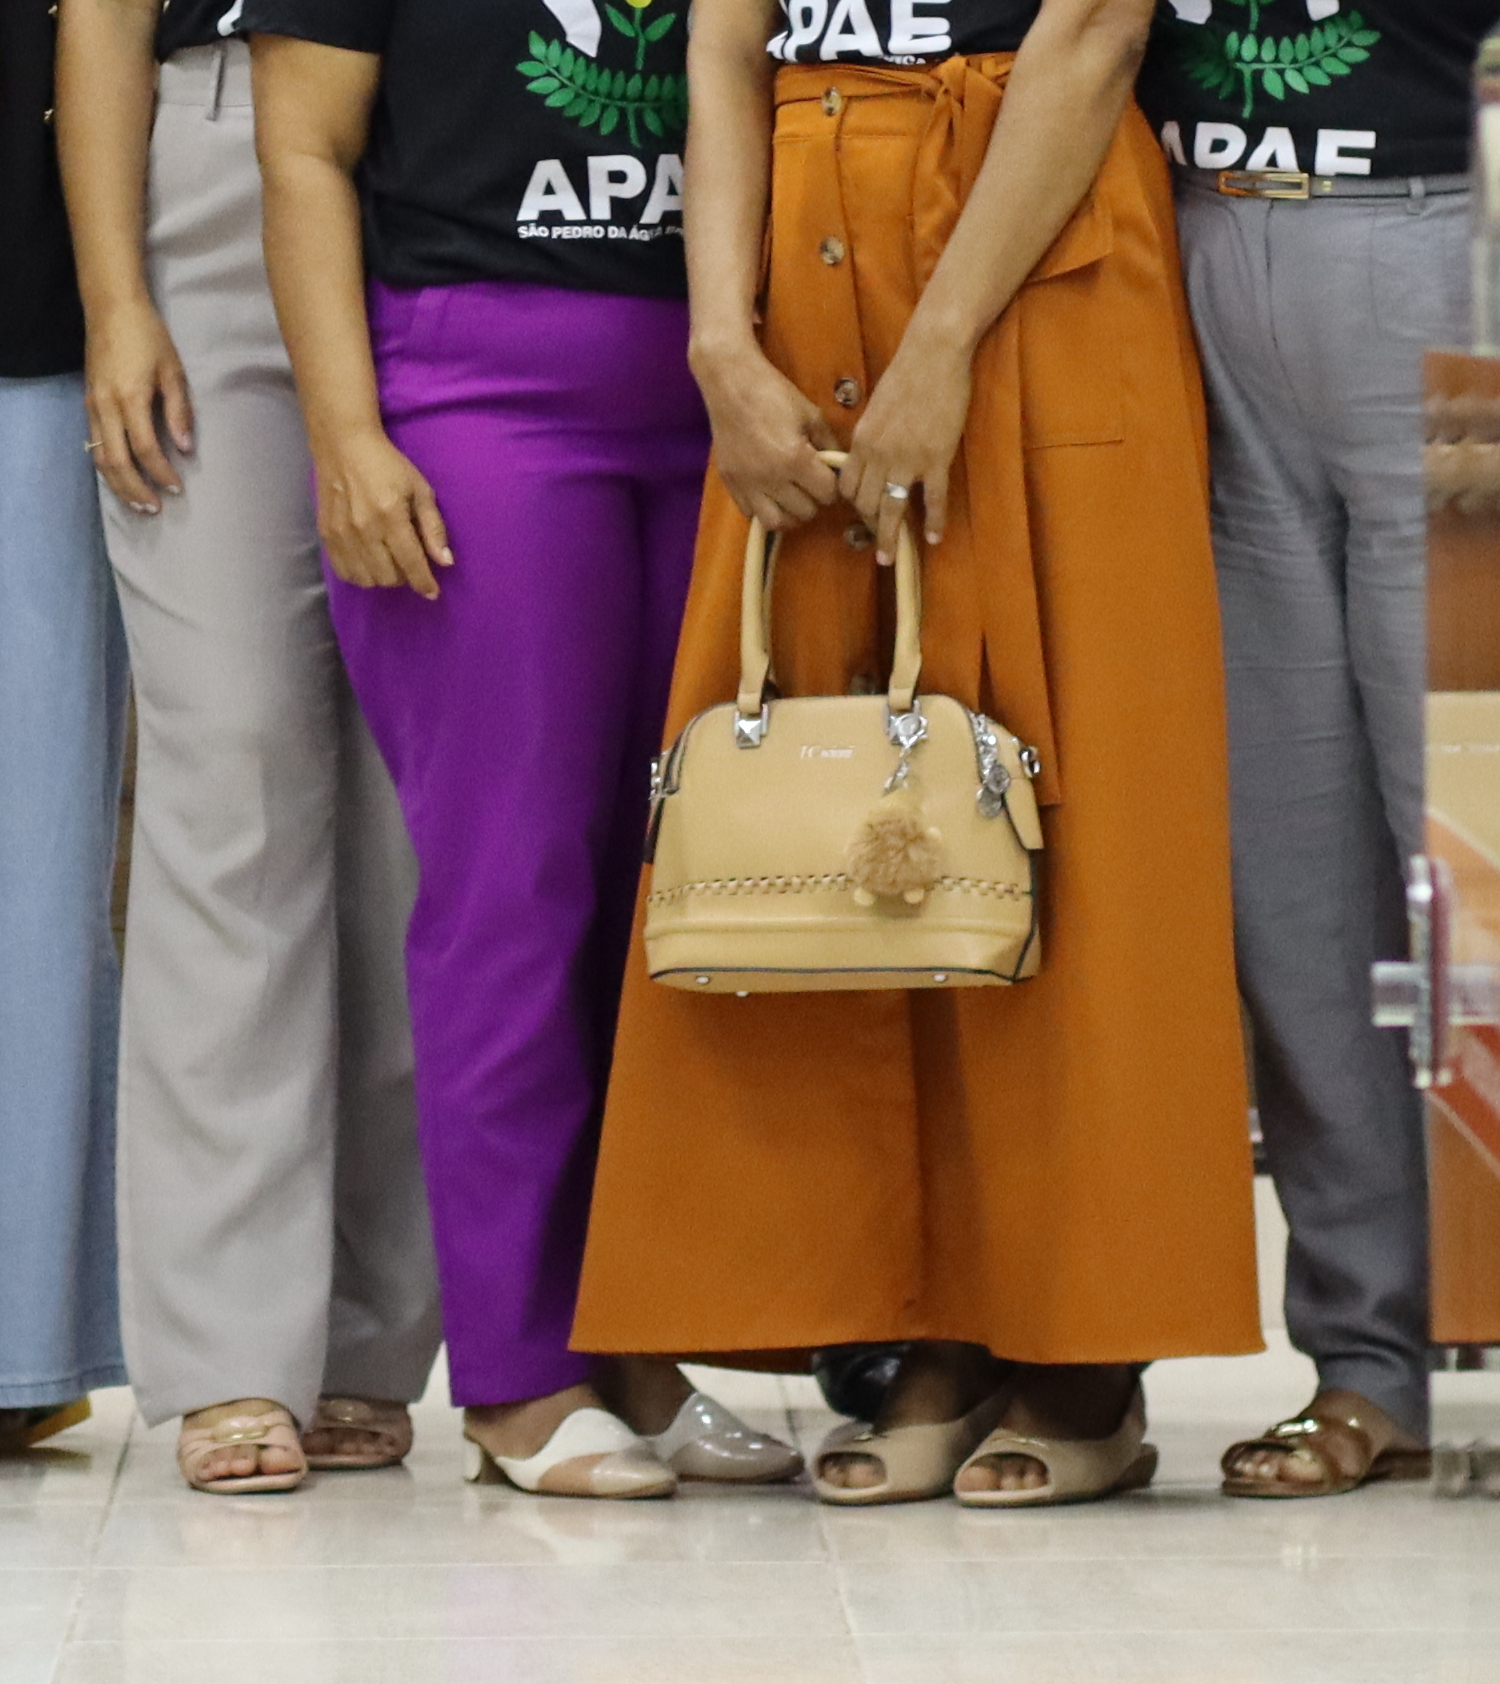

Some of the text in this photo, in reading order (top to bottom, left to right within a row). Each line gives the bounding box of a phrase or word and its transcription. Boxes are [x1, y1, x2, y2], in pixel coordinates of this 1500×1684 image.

[517, 223, 549, 238] SÃO
[551, 225, 605, 239] PEDRO
[607, 225, 627, 239] DA
